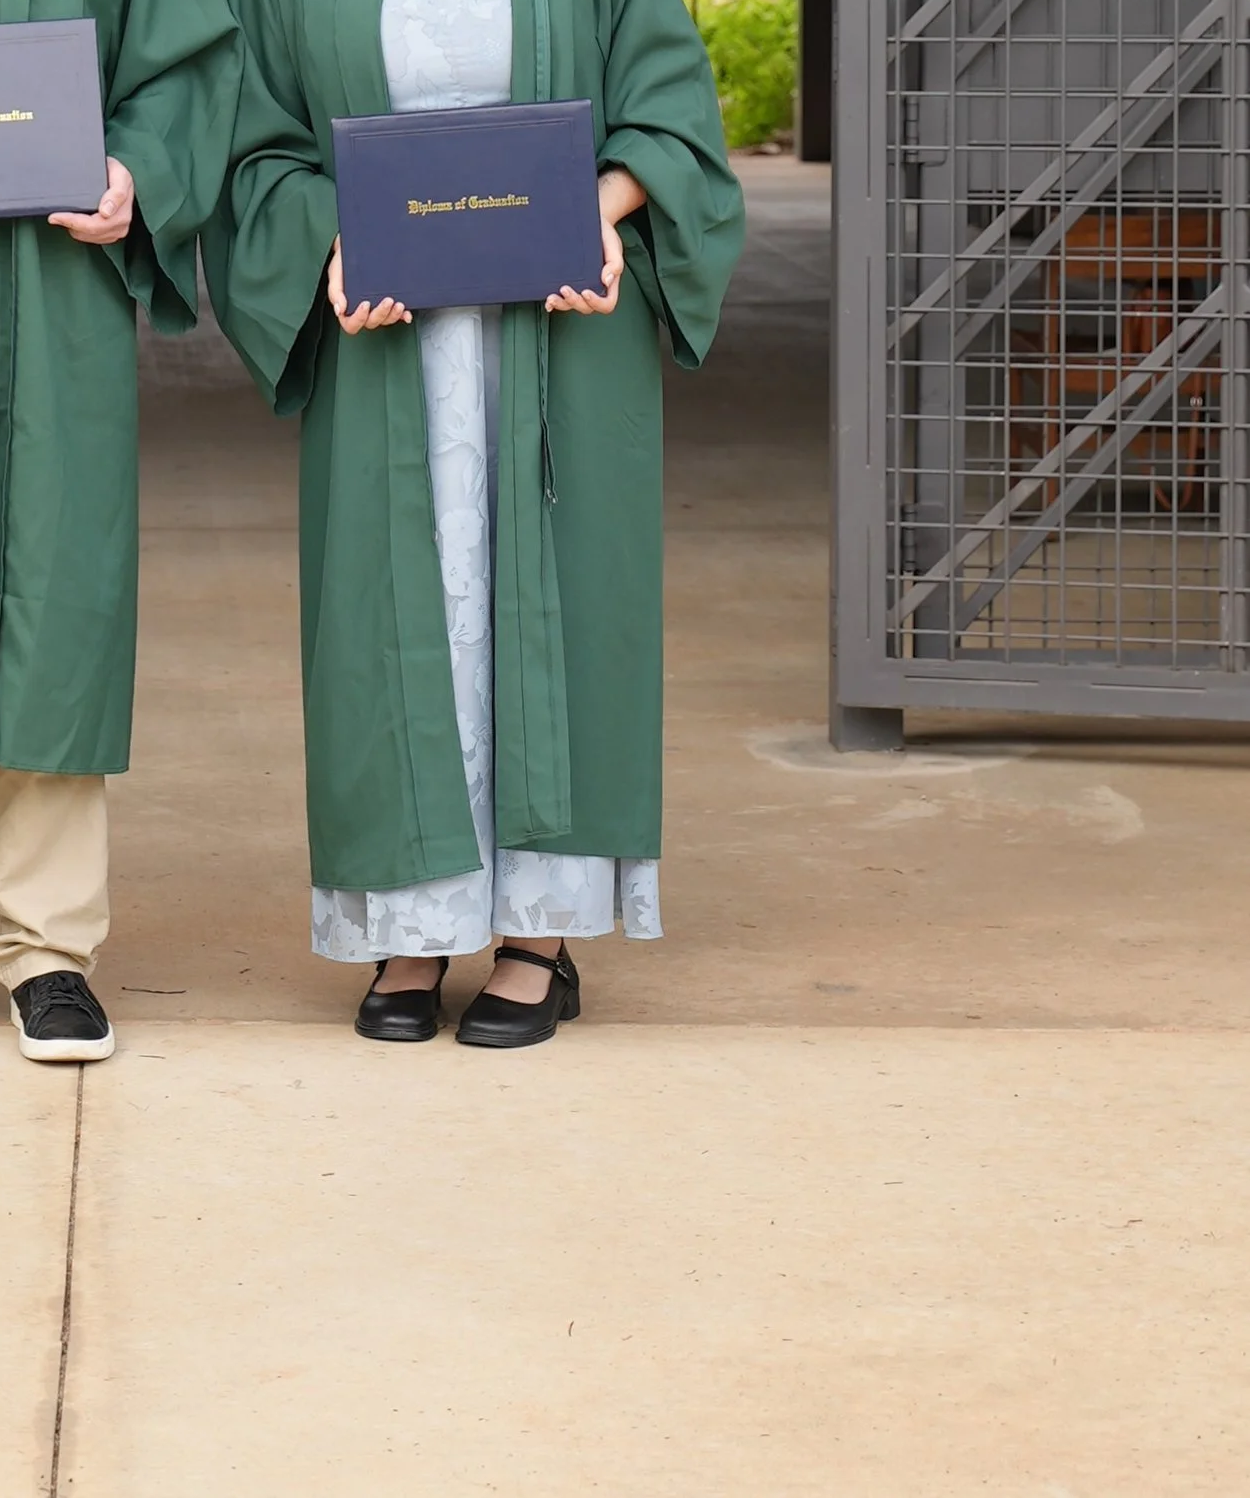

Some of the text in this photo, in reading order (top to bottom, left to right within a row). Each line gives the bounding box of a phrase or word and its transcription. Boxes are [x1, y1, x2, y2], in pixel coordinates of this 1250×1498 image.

[407, 193, 530, 216] Diploma of Graduation
